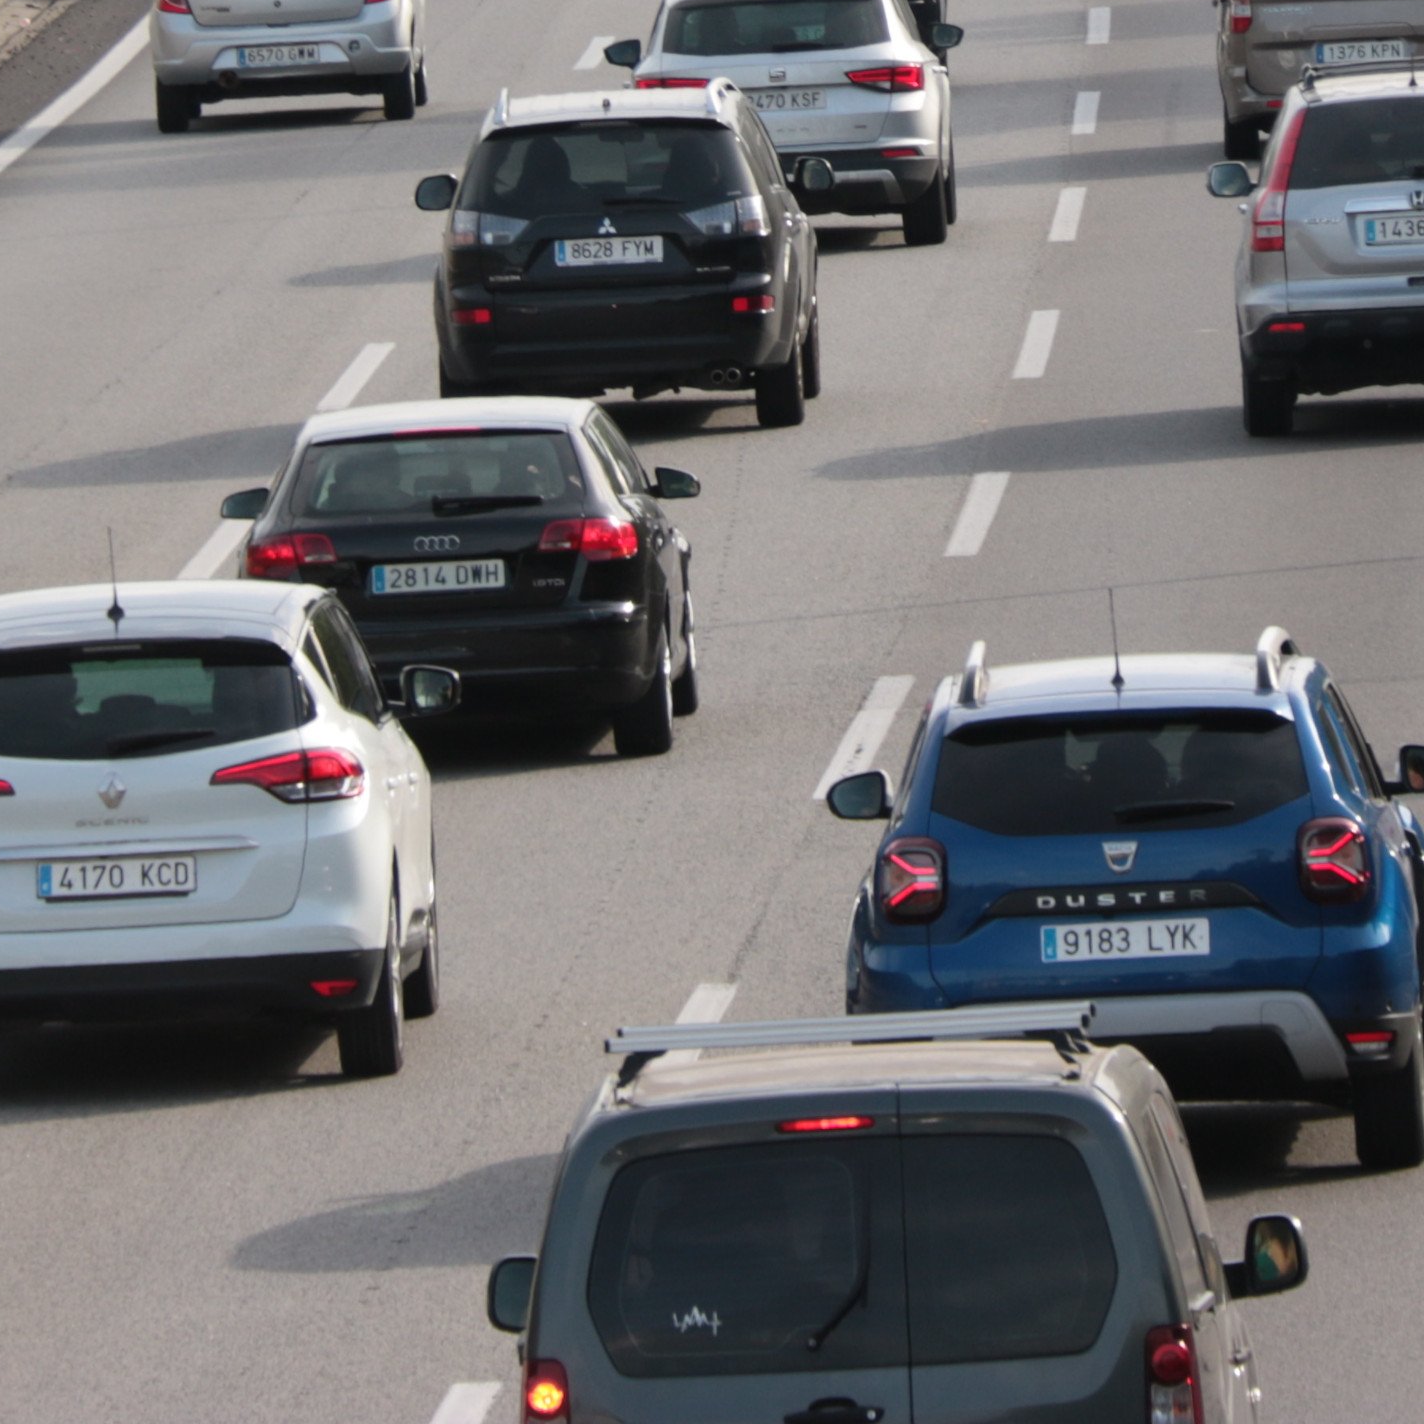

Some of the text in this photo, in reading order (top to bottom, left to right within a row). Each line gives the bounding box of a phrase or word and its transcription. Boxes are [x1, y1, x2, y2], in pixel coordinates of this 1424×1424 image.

[248, 47, 285, 63] 6570
[1329, 43, 1401, 60] 1376 KPN
[791, 91, 821, 108] KSF
[571, 239, 655, 260] 8628 FYM
[390, 563, 499, 589] 2814 DWH
[59, 861, 189, 890] 4170 KCD
[1036, 889, 1207, 909] DUSTER
[1063, 922, 1198, 956] 9183 LYK
